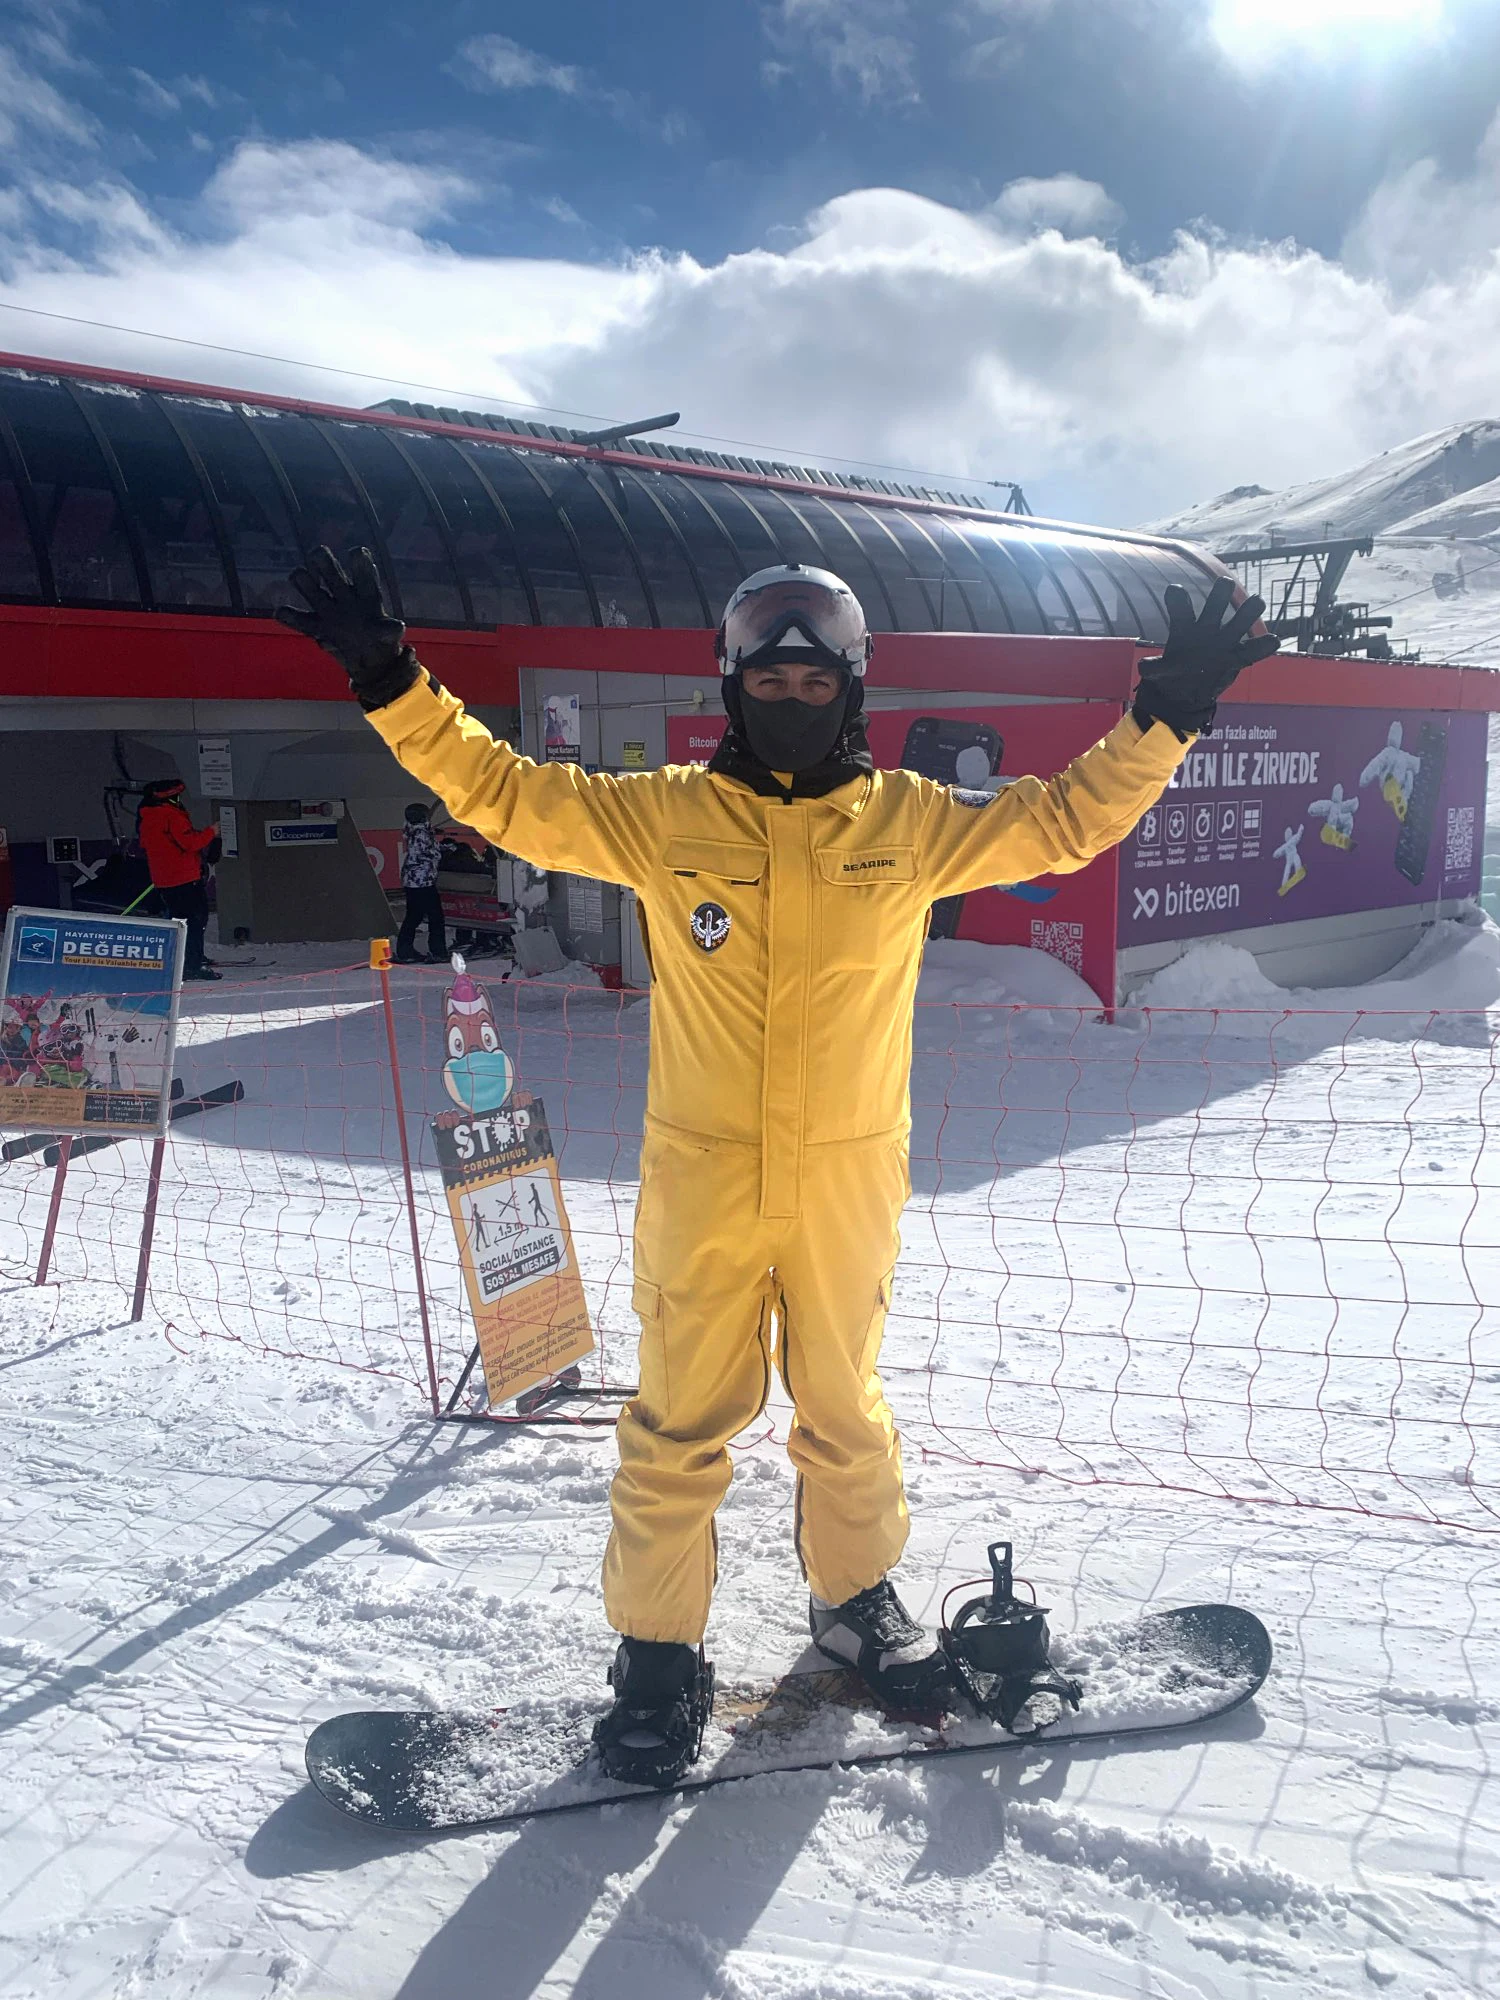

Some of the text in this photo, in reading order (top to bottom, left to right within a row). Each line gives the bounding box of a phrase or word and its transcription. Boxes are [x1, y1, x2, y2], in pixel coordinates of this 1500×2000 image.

[1225, 725, 1248, 740] fazla
[1248, 725, 1277, 740] altcoin
[689, 736, 718, 748] Bitcoin
[1222, 742, 1249, 787] İLE
[1252, 742, 1320, 785] ZİRVEDE
[843, 859, 896, 871] SEARIPE
[1165, 881, 1240, 916] bitexen
[65, 931, 165, 944] HAYATINIZ BİZİM İÇİN
[62, 941, 163, 959] DEĞERLİ
[104, 958, 137, 967] Valuable
[463, 1147, 528, 1174] CORONAVIRUS
[498, 1222, 513, 1236] 1,5
[479, 1234, 556, 1274] SOCIAL DISTANCE
[485, 1268, 520, 1290] SOSYAL
[521, 1251, 556, 1275] MESAFE
